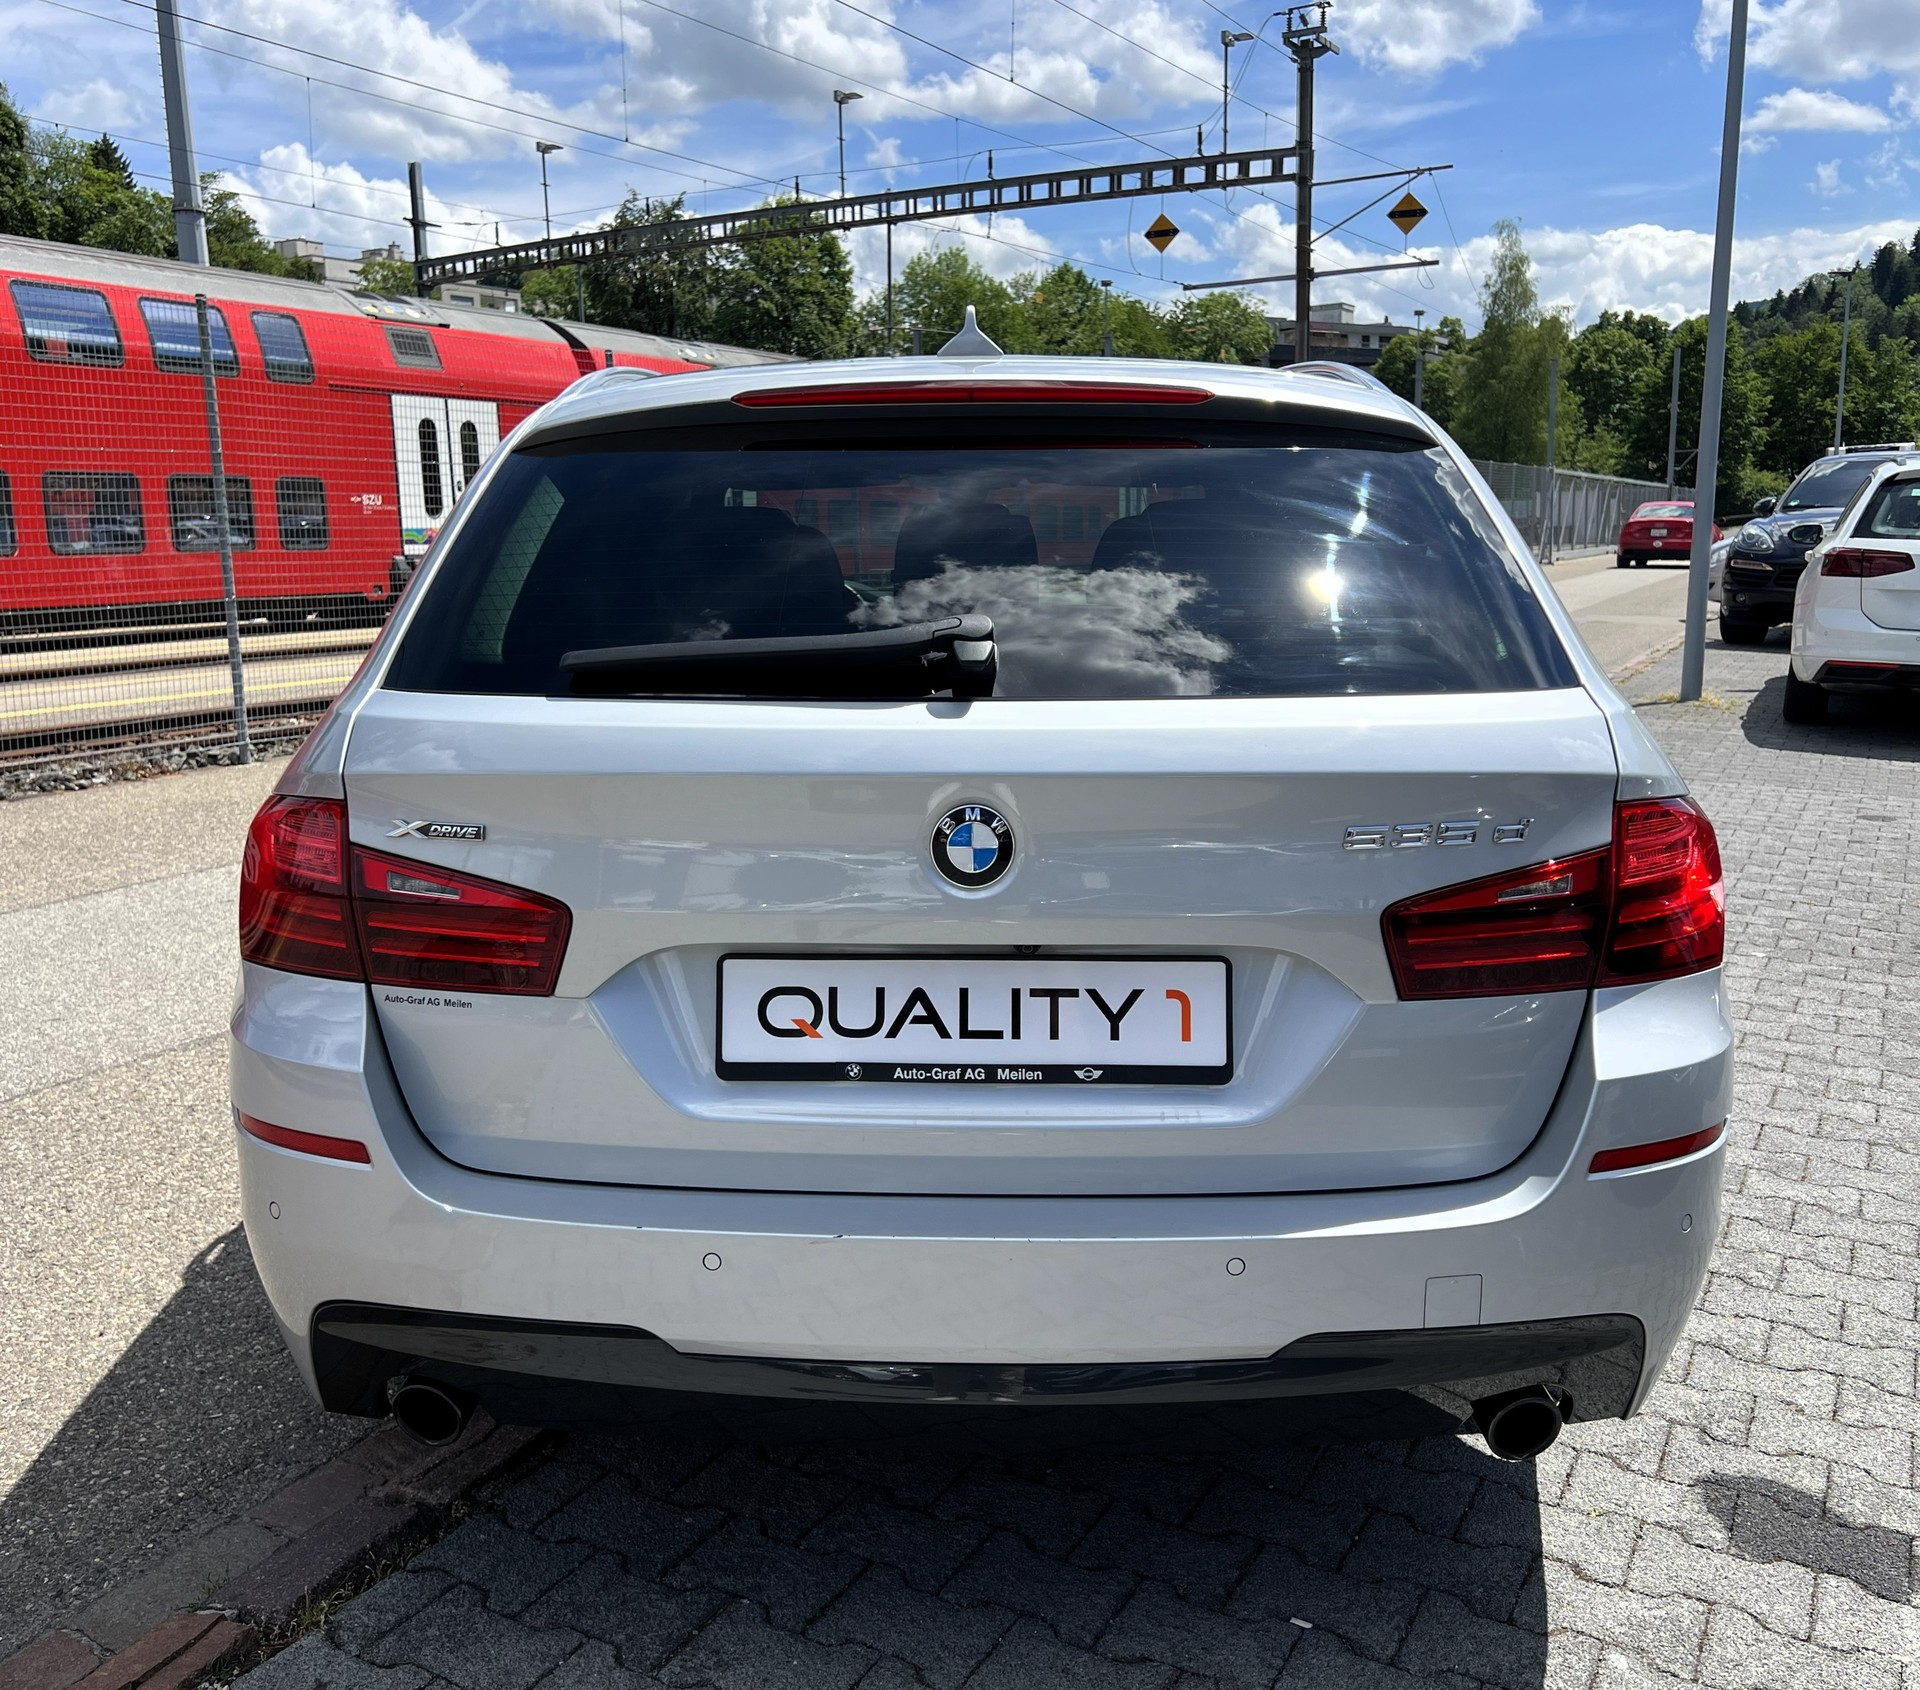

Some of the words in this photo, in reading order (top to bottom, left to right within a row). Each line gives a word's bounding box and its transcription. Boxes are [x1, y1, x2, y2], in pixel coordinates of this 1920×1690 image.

[362, 494, 382, 506] SZU
[939, 807, 1007, 834] BMW
[1343, 820, 1480, 850] 535
[1494, 818, 1534, 844] d
[384, 993, 426, 1006] Auto-Graf
[427, 996, 441, 1007] AG
[443, 997, 473, 1009] Meilen
[757, 985, 1145, 1042] QUALITY
[1165, 988, 1192, 1043] 1
[893, 1067, 961, 1081] Auto-Graf
[964, 1068, 985, 1081] AG
[997, 1068, 1043, 1081] Meilen
